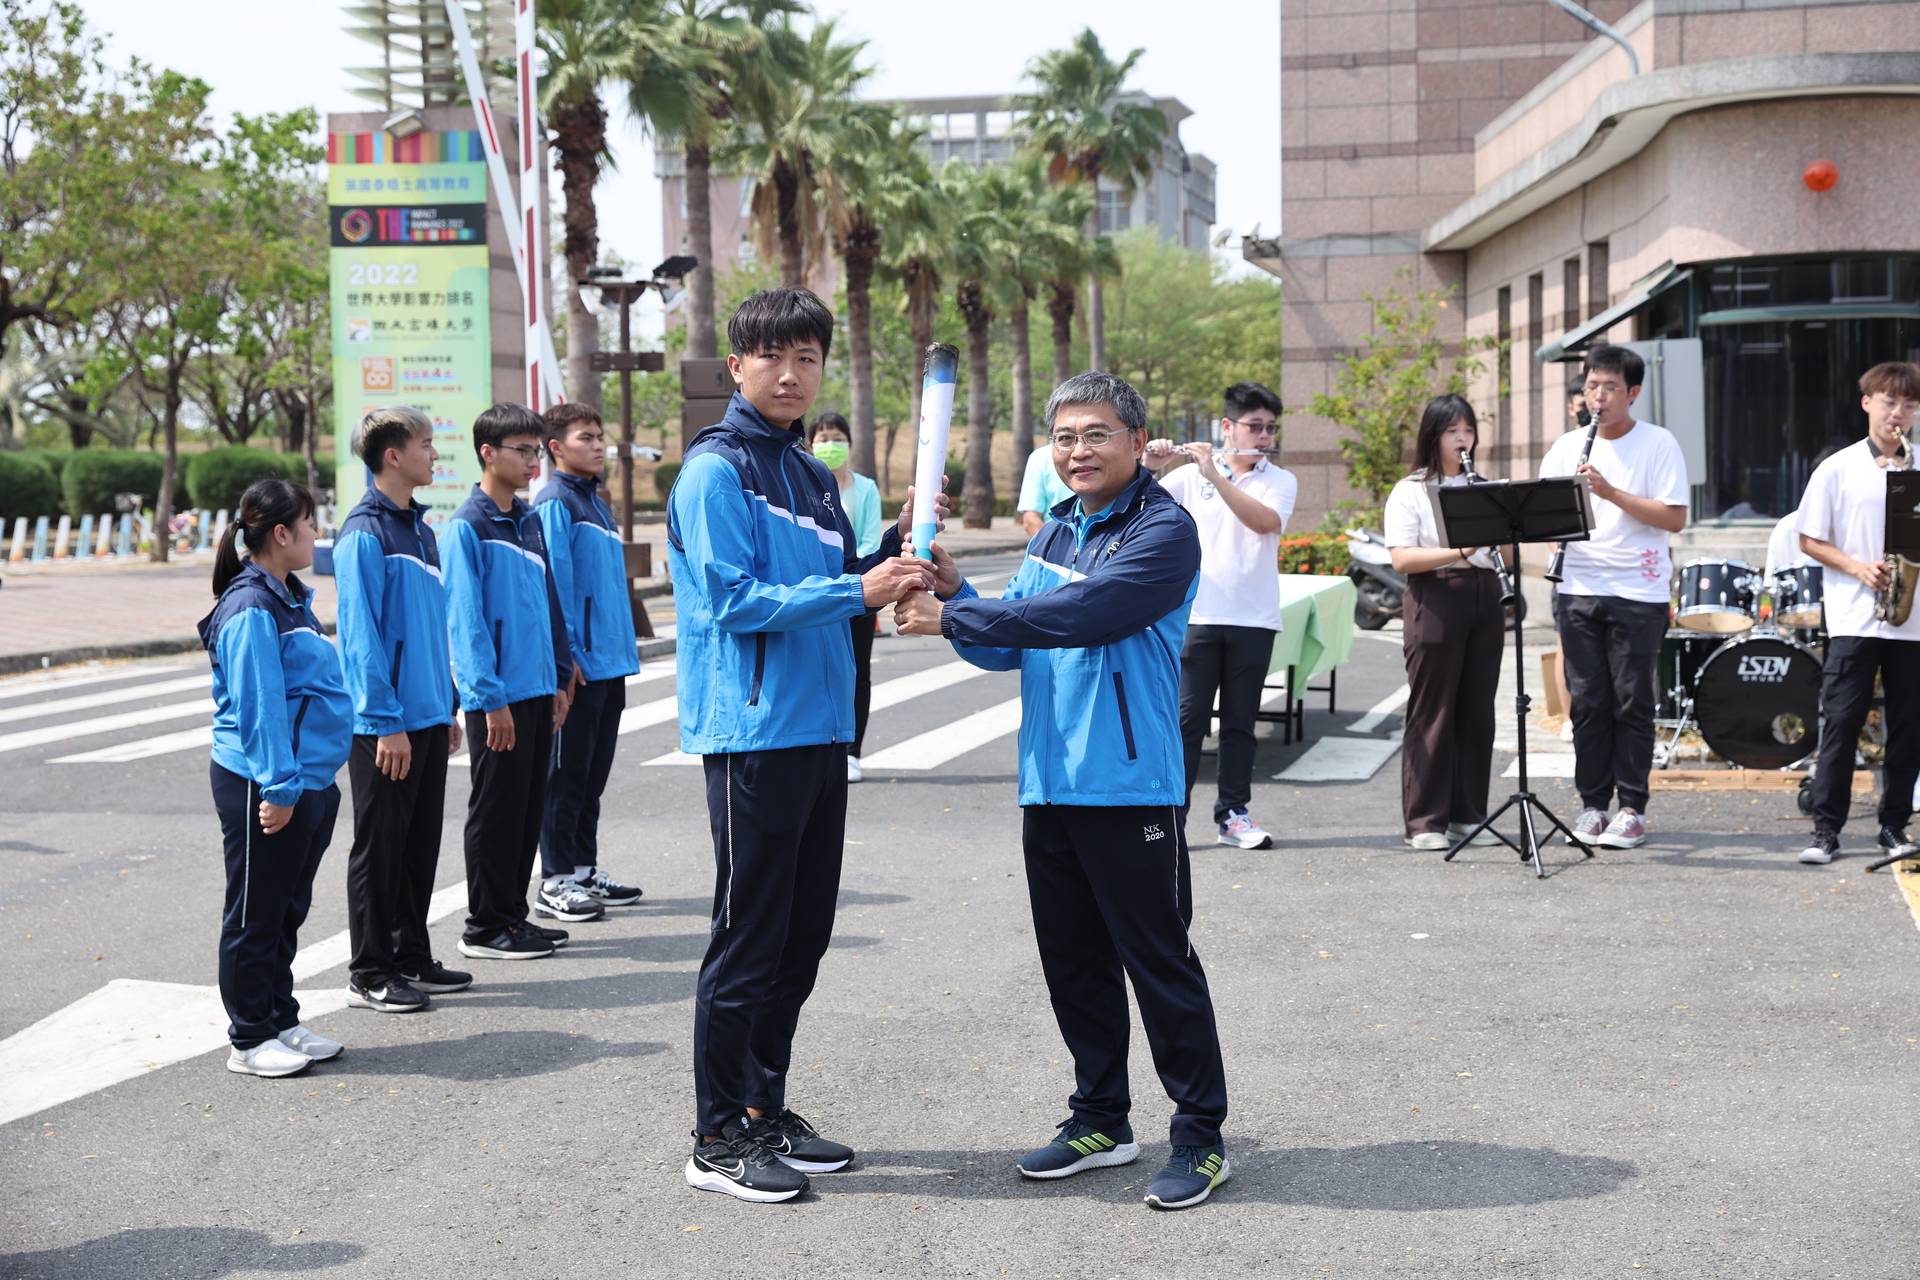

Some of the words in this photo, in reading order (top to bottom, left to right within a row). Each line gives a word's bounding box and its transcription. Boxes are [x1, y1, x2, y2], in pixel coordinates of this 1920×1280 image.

[376, 208, 411, 242] THE
[348, 263, 419, 286] 2022
[347, 291, 474, 307] 世界大學影響力排名
[1145, 831, 1165, 842] 2020
